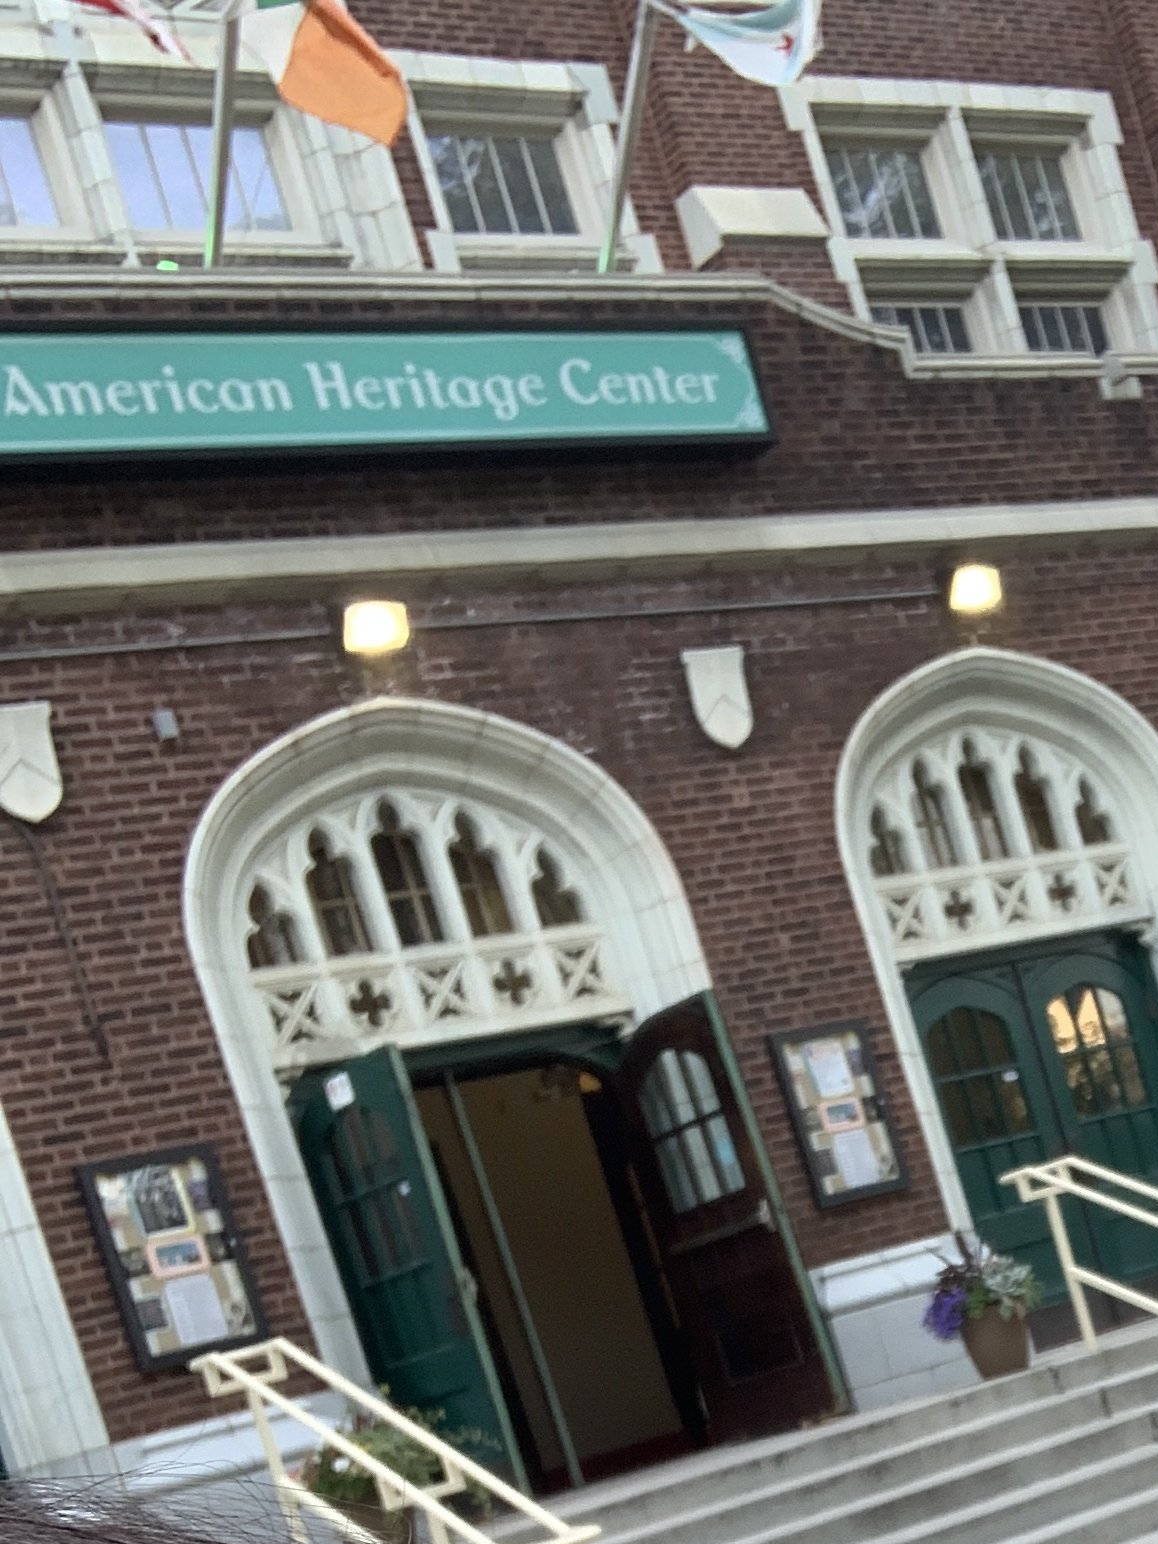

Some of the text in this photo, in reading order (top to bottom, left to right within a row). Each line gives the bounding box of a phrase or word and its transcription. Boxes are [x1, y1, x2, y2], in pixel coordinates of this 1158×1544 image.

[1, 358, 719, 421] American Heritage Center
